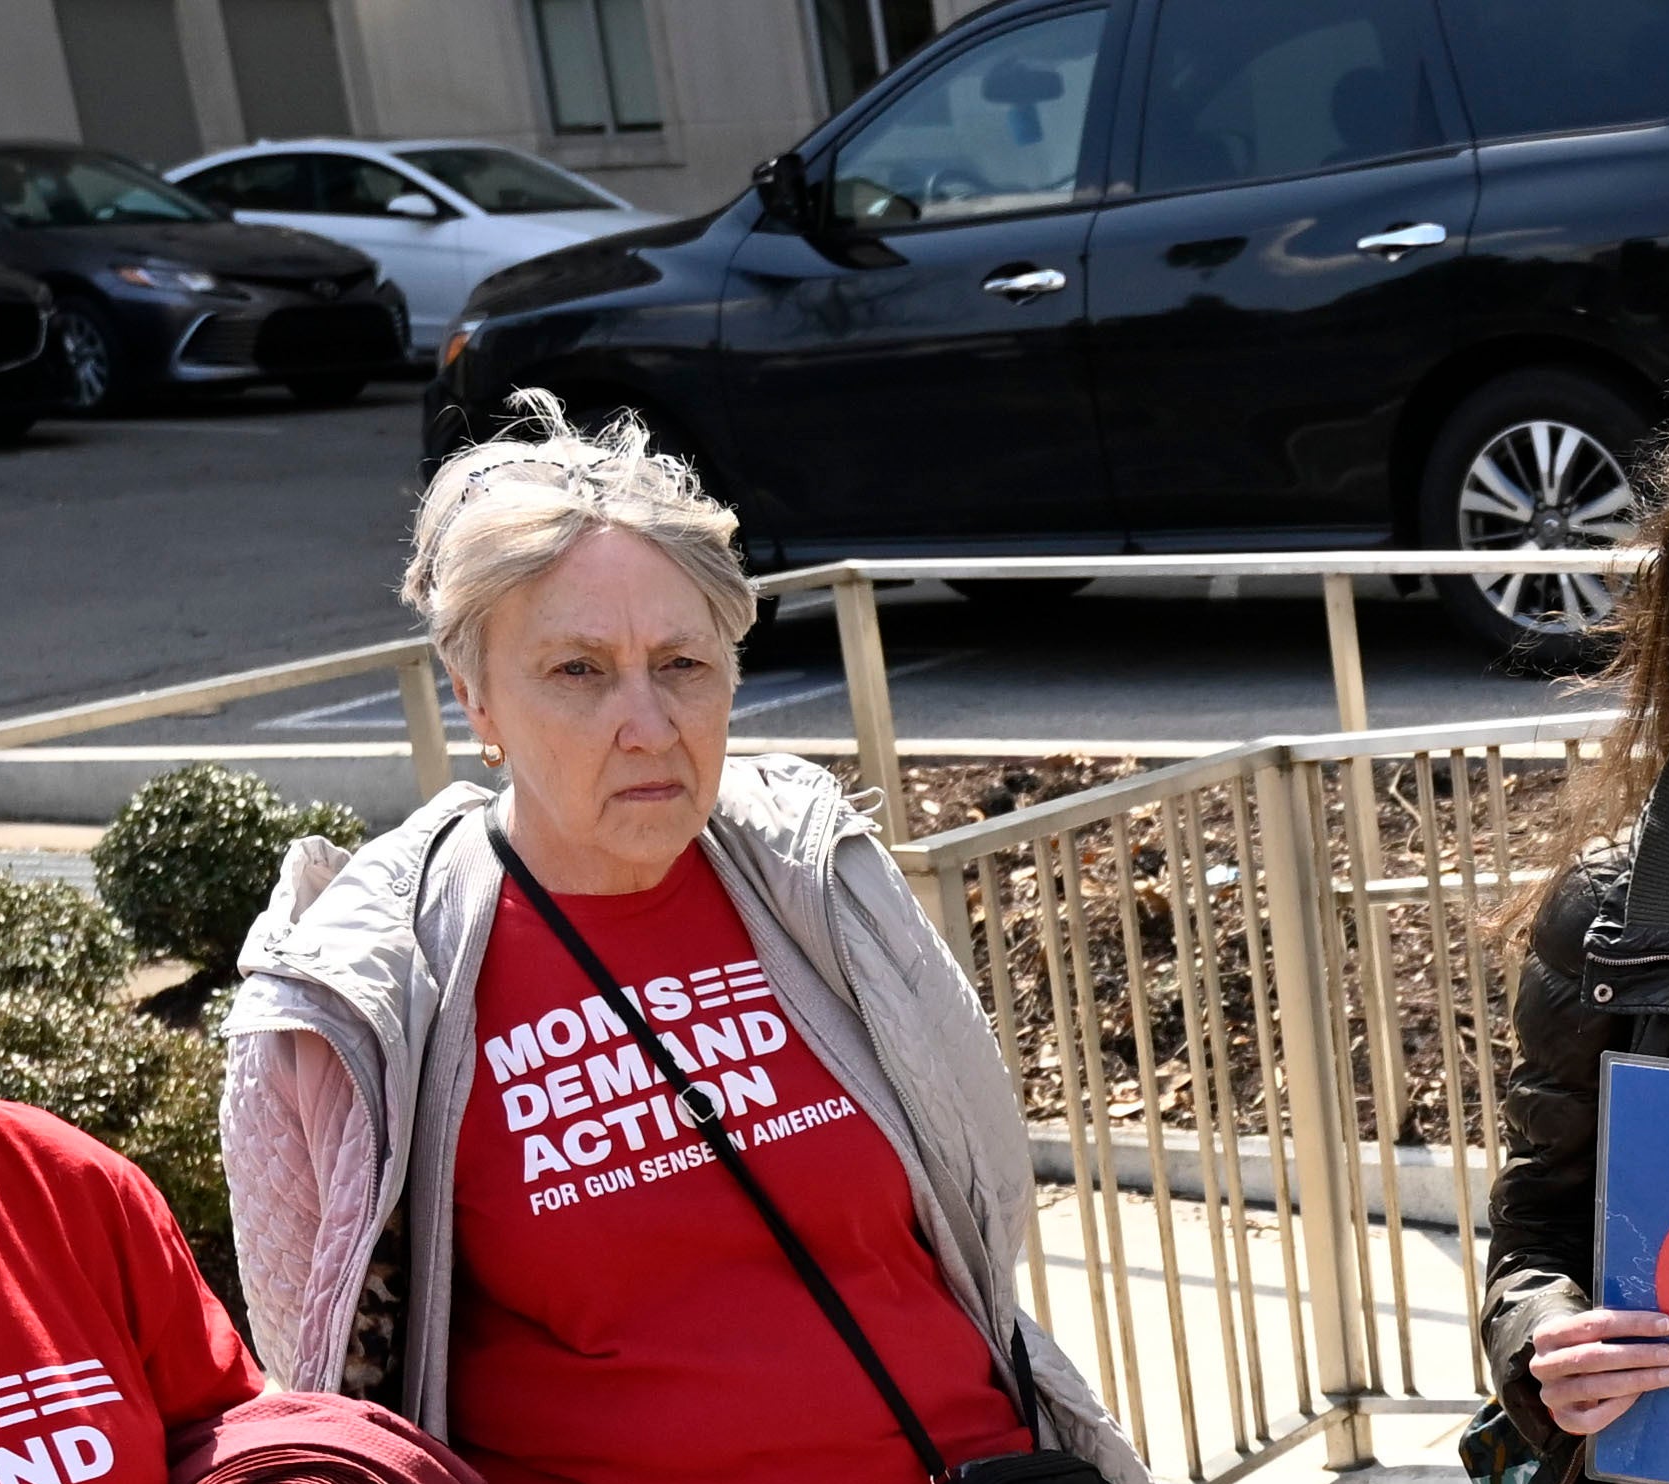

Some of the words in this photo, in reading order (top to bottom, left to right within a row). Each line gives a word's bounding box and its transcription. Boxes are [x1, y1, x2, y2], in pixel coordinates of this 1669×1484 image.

[484, 976, 693, 1085] MOMS
[501, 1010, 787, 1134] DEMAND
[523, 1065, 778, 1184] ACTION
[530, 1182, 580, 1216] FOR
[584, 1166, 636, 1199] GUN
[639, 1141, 718, 1184] SENSE
[726, 1129, 748, 1152] N
[753, 1095, 856, 1147] AMERICA
